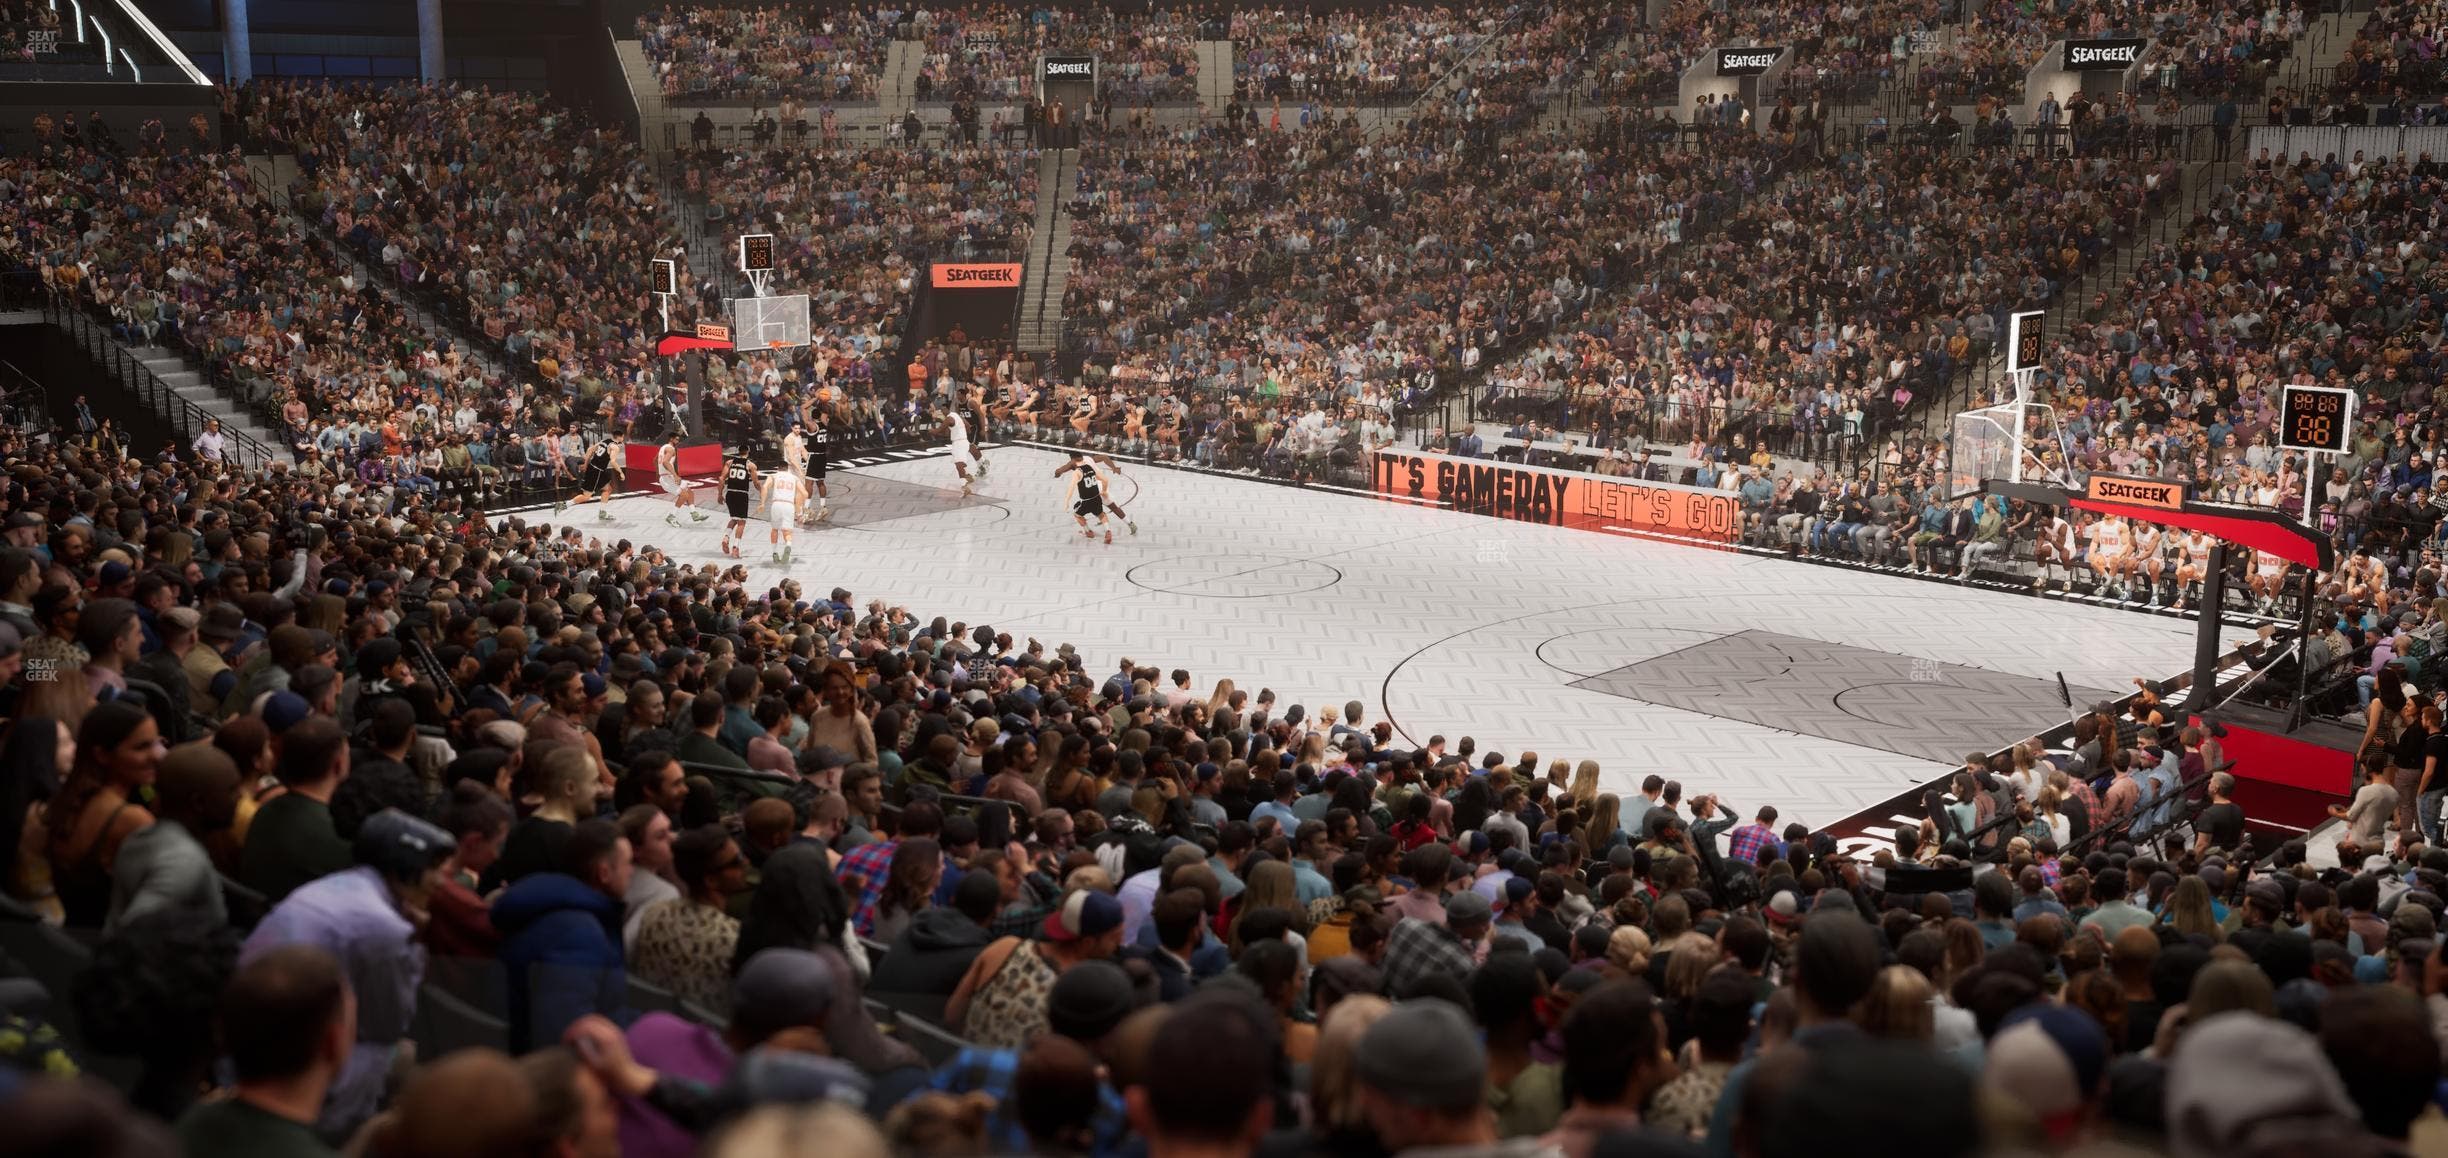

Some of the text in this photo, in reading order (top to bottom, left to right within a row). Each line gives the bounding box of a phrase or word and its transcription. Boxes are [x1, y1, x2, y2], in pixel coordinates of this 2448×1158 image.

[1723, 53, 1776, 69] SEATGEEK
[2071, 45, 2137, 63] SEATGEEK
[1047, 62, 1092, 75] SEATGEEK
[946, 268, 1013, 281] SEATGEEK
[729, 468, 747, 480] 00
[1373, 452, 1425, 490] IT'S
[1438, 461, 1570, 511] GAMEDAY
[1583, 479, 1672, 526] LET'S
[2098, 482, 2171, 504] SEATGEEK
